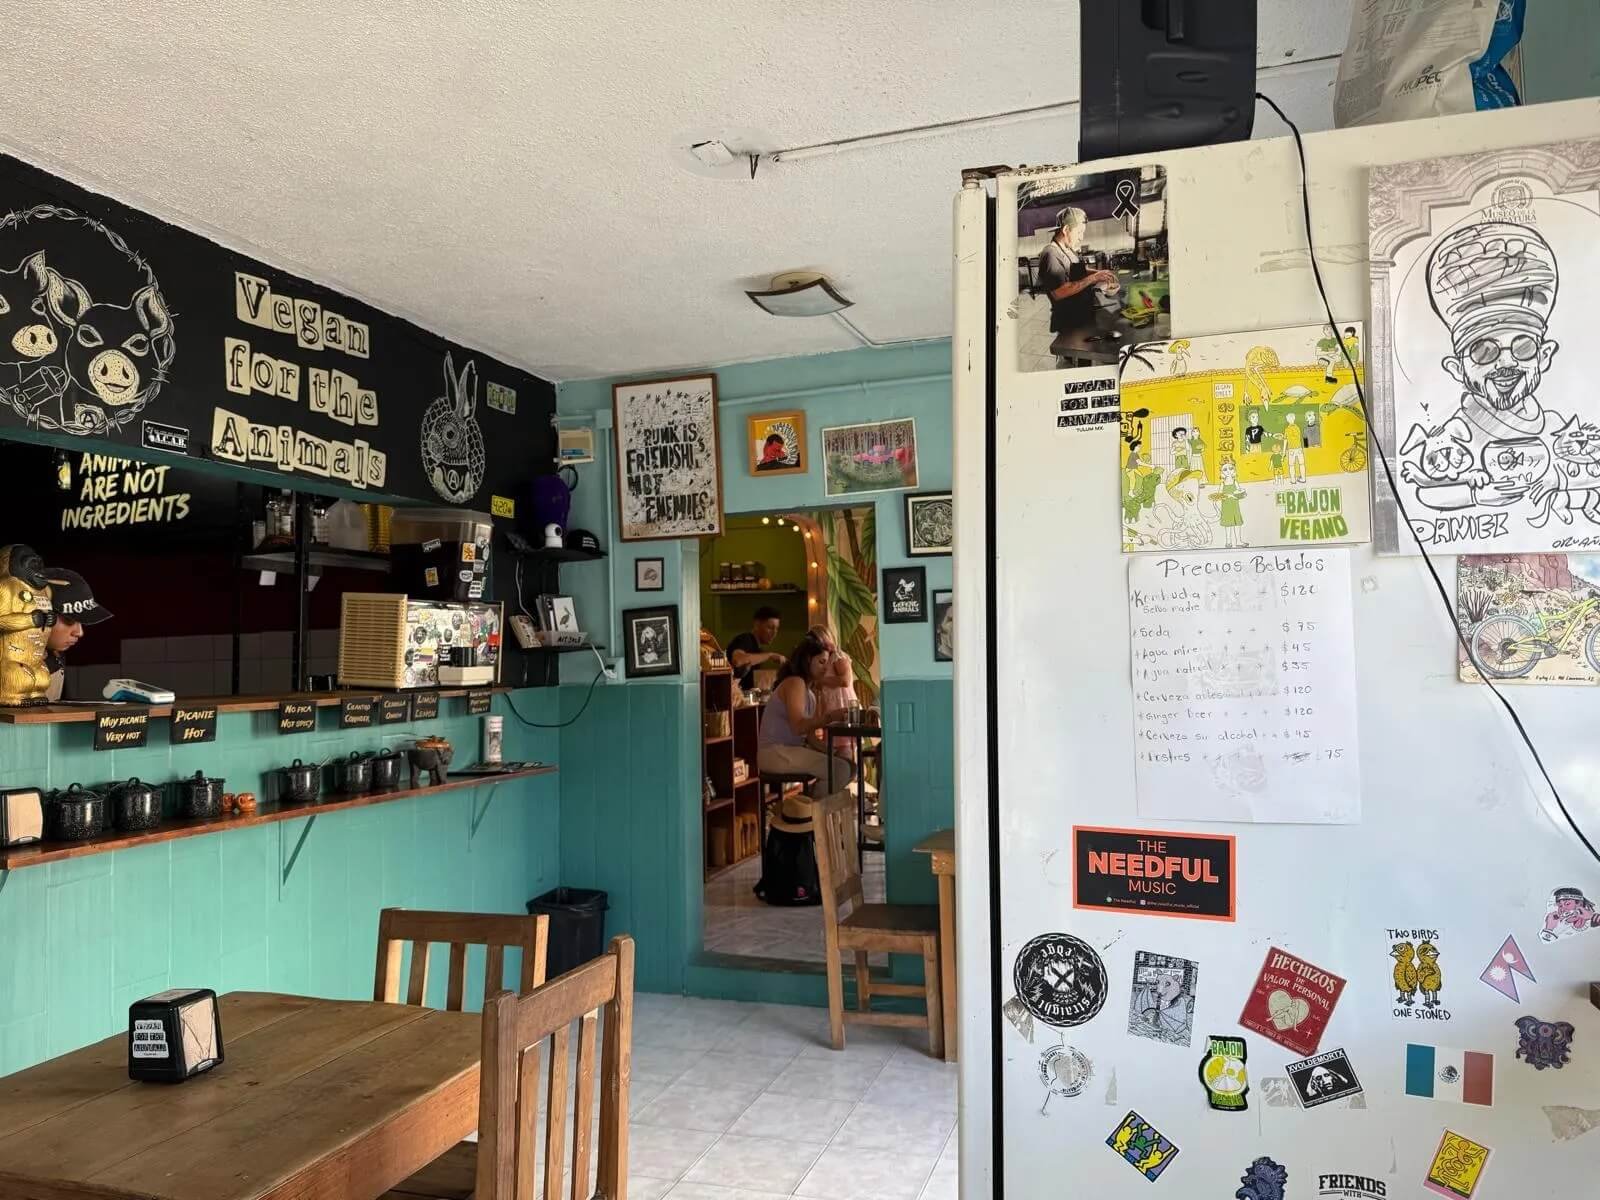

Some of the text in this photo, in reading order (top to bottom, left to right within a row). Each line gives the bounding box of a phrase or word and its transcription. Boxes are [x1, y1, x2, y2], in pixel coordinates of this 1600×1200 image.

[238, 276, 368, 355] Vegan
[230, 344, 374, 421] for the
[1064, 379, 1116, 394] VEGAN
[1061, 394, 1120, 411] FOR THE
[215, 416, 383, 485] Animals
[80, 466, 171, 502] ARE NOT
[61, 493, 191, 531] INGREDIENTS
[1286, 488, 1341, 514] BAJON
[1279, 515, 1348, 540] VEGANO
[1156, 558, 1243, 578] Precios
[1137, 840, 1167, 854] THE
[1088, 851, 1219, 884] NEEDFUL
[1128, 880, 1176, 895] MUSIC
[1387, 929, 1440, 940] TWO BIRDS
[1270, 953, 1338, 994] HECHIZOS
[1295, 976, 1306, 984] DE
[1263, 972, 1331, 1011] VALOR PERSONAL
[1393, 1008, 1452, 1021] ONE STONED
[1211, 1040, 1244, 1058] BAJON
[1287, 1049, 1345, 1073] XVOLDEMORTX
[1318, 1174, 1387, 1197] FRIENDS
[1343, 1189, 1362, 1199] WITH
